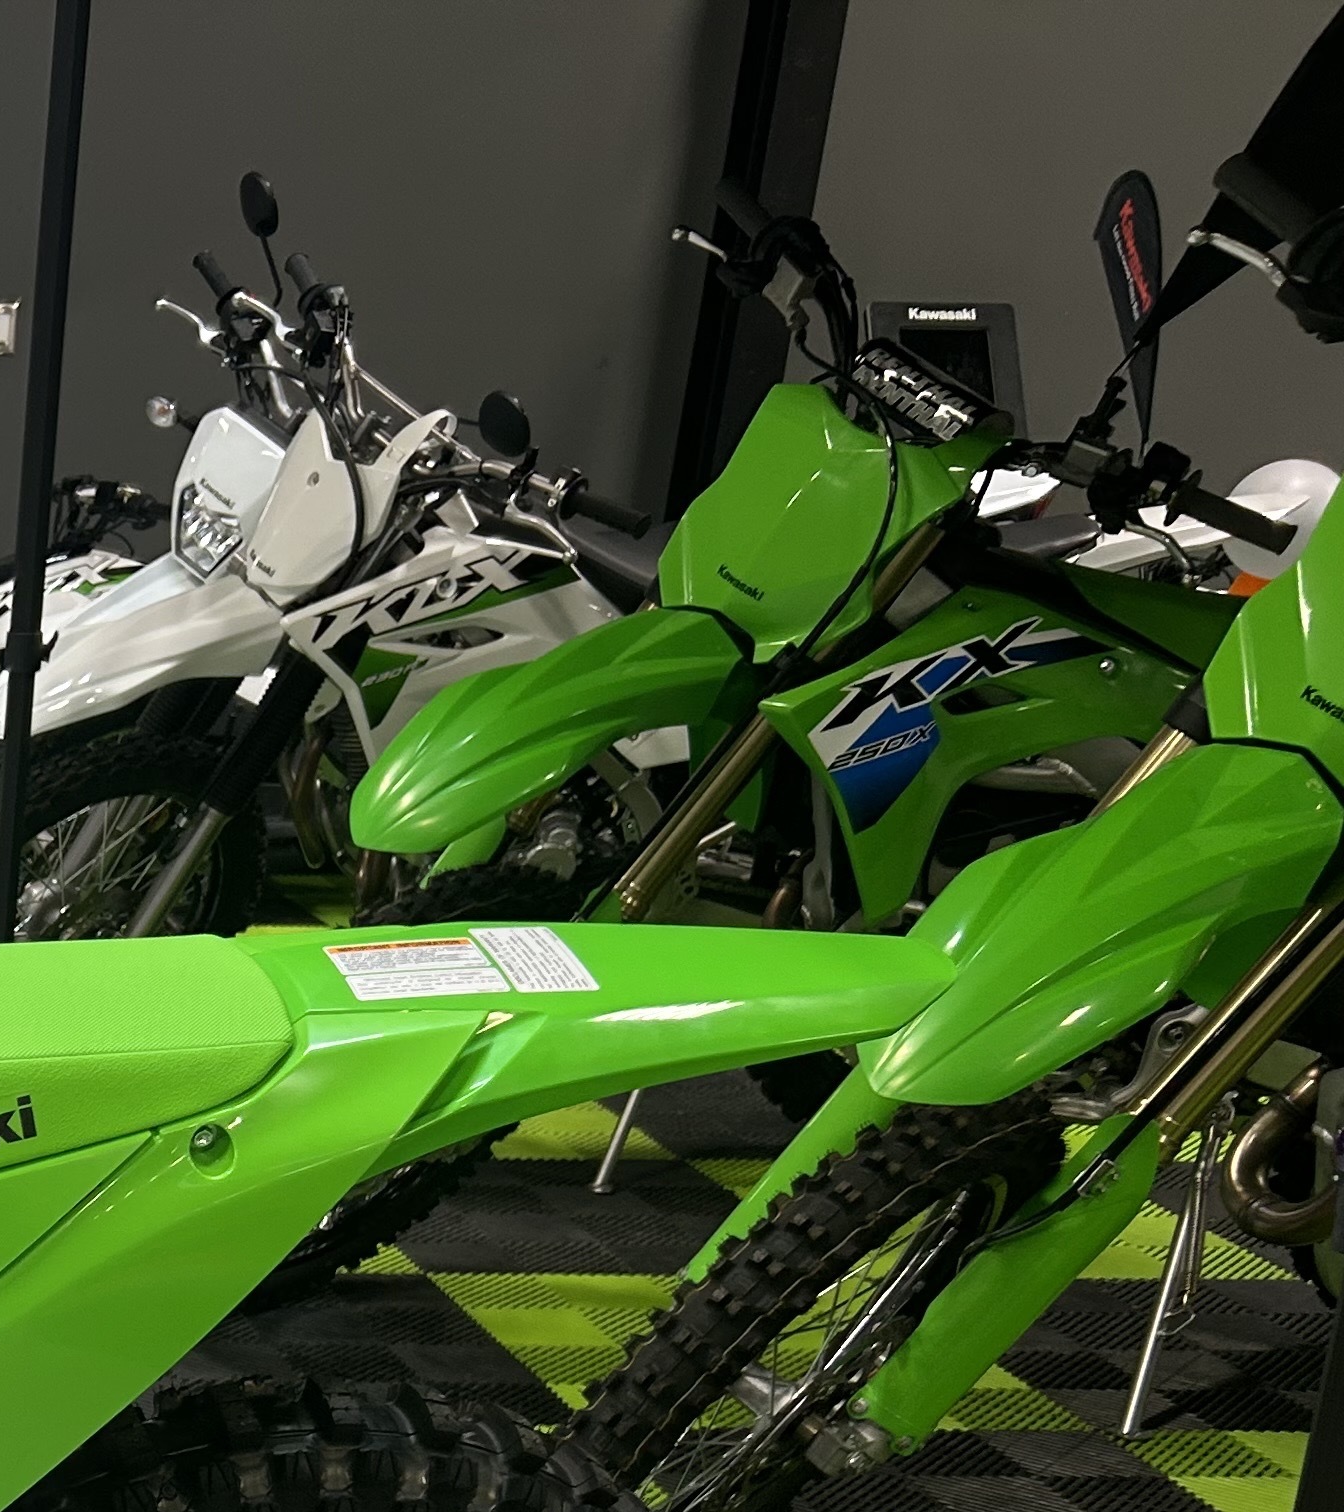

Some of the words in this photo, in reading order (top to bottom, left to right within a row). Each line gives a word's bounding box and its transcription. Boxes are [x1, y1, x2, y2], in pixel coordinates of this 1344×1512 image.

[908, 307, 977, 321] Kawasaki
[716, 563, 765, 602] Kawasaki
[820, 616, 1041, 733] KX
